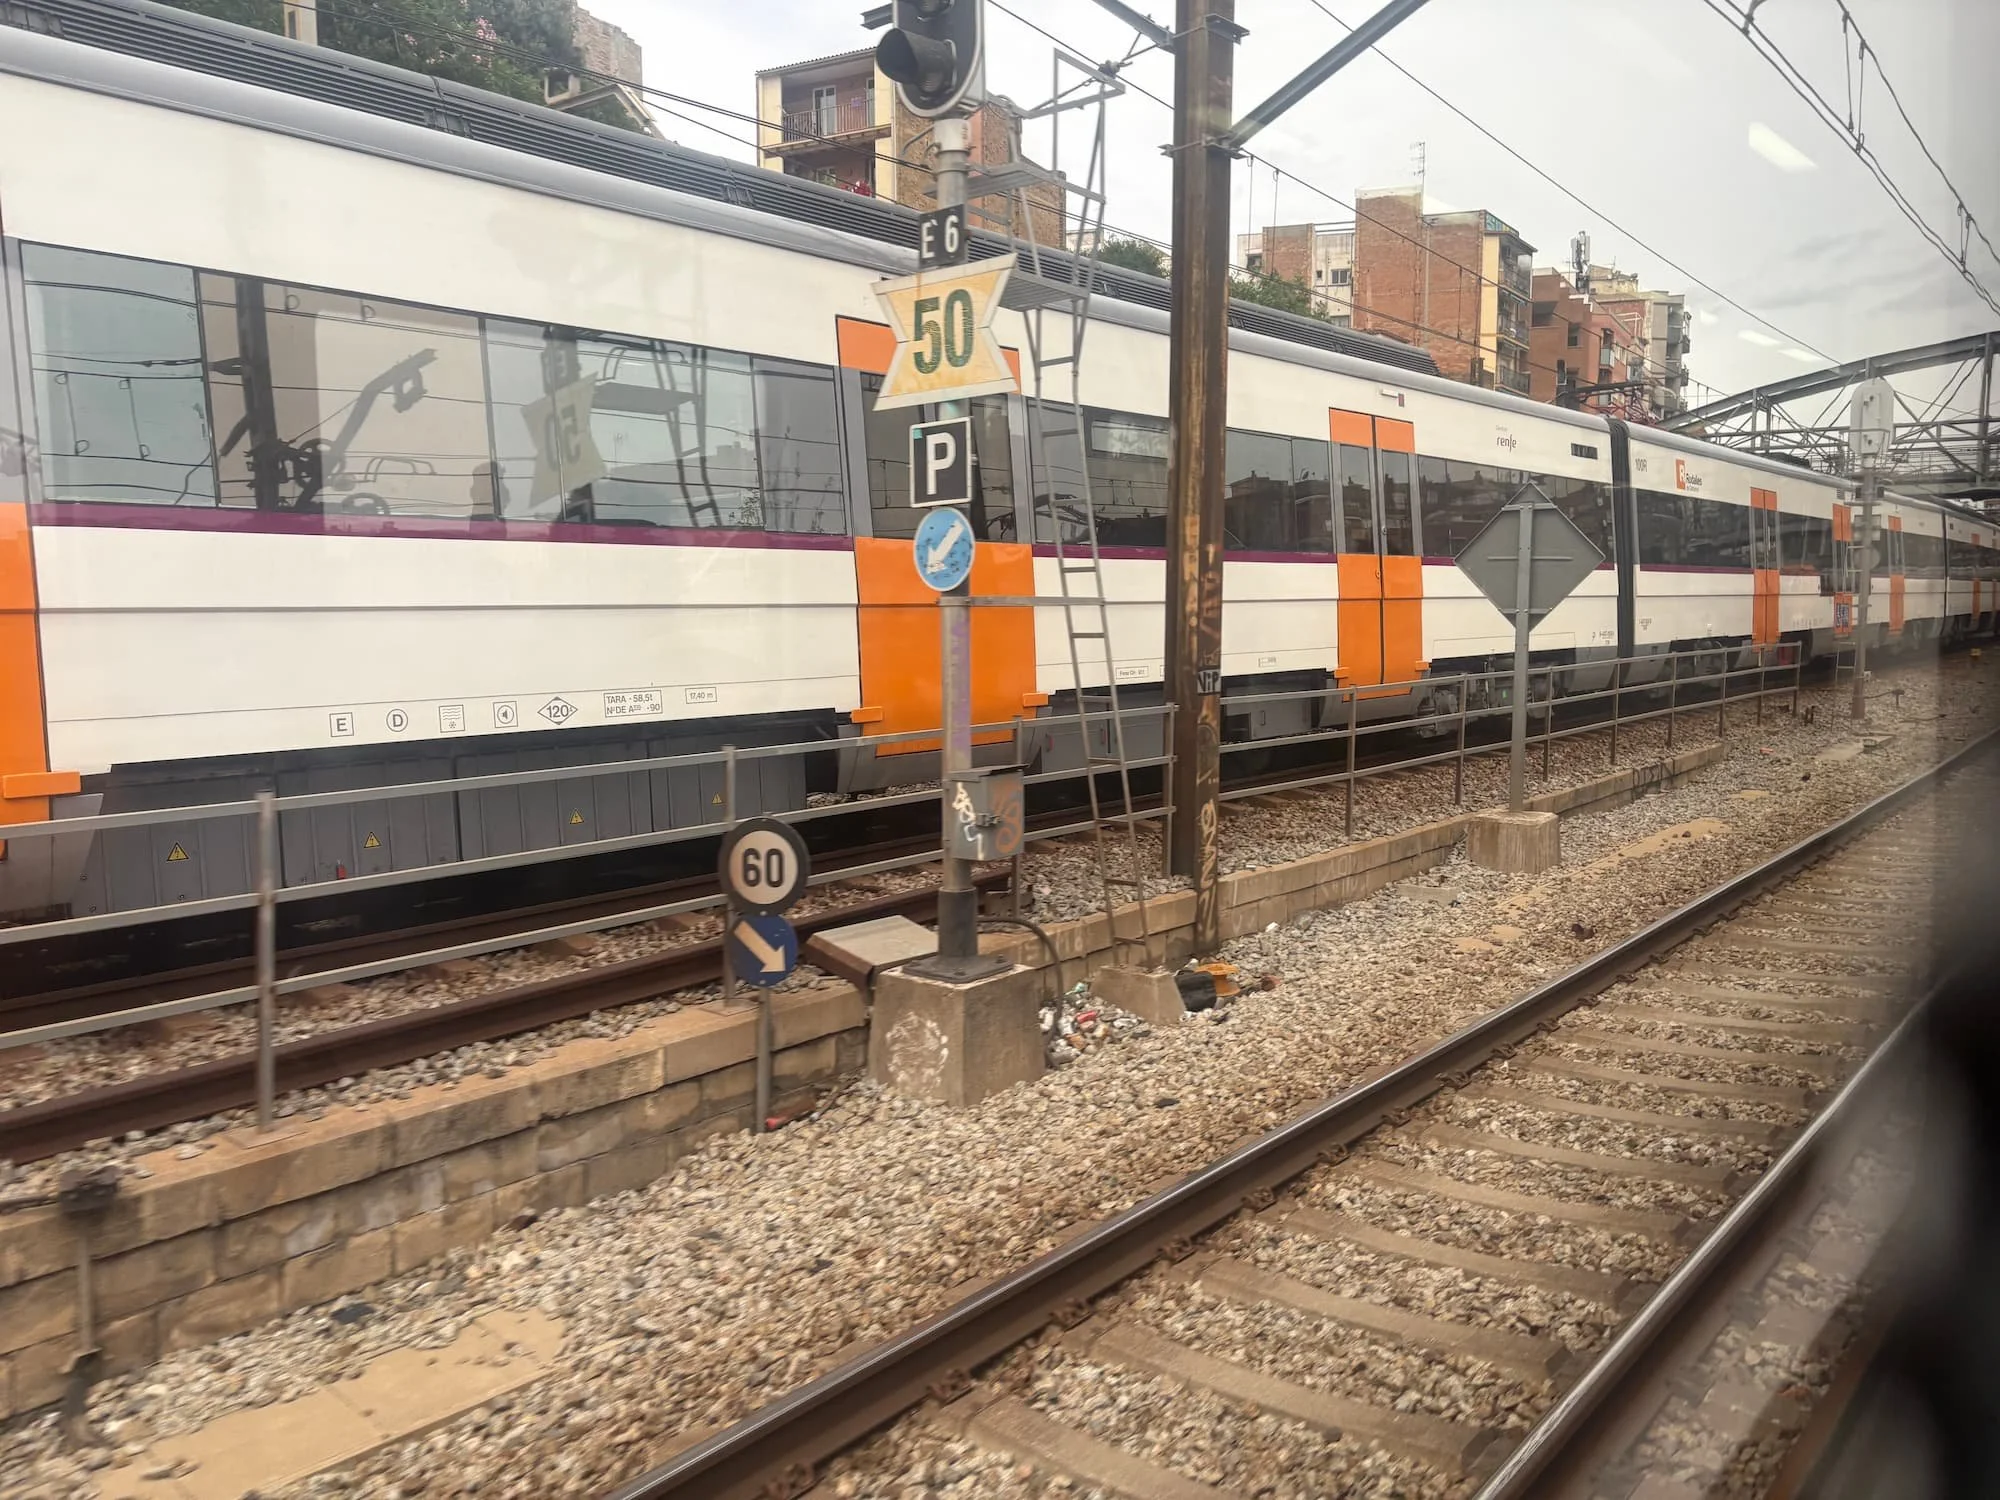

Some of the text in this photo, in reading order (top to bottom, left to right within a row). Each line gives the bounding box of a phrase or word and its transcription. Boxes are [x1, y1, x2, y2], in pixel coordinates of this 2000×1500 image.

[913, 288, 974, 375] 50
[1496, 434, 1517, 453] renfe
[926, 431, 957, 496] P
[606, 694, 627, 704] TARA
[336, 717, 348, 732] E
[392, 713, 404, 728] D
[743, 847, 785, 888] 60
